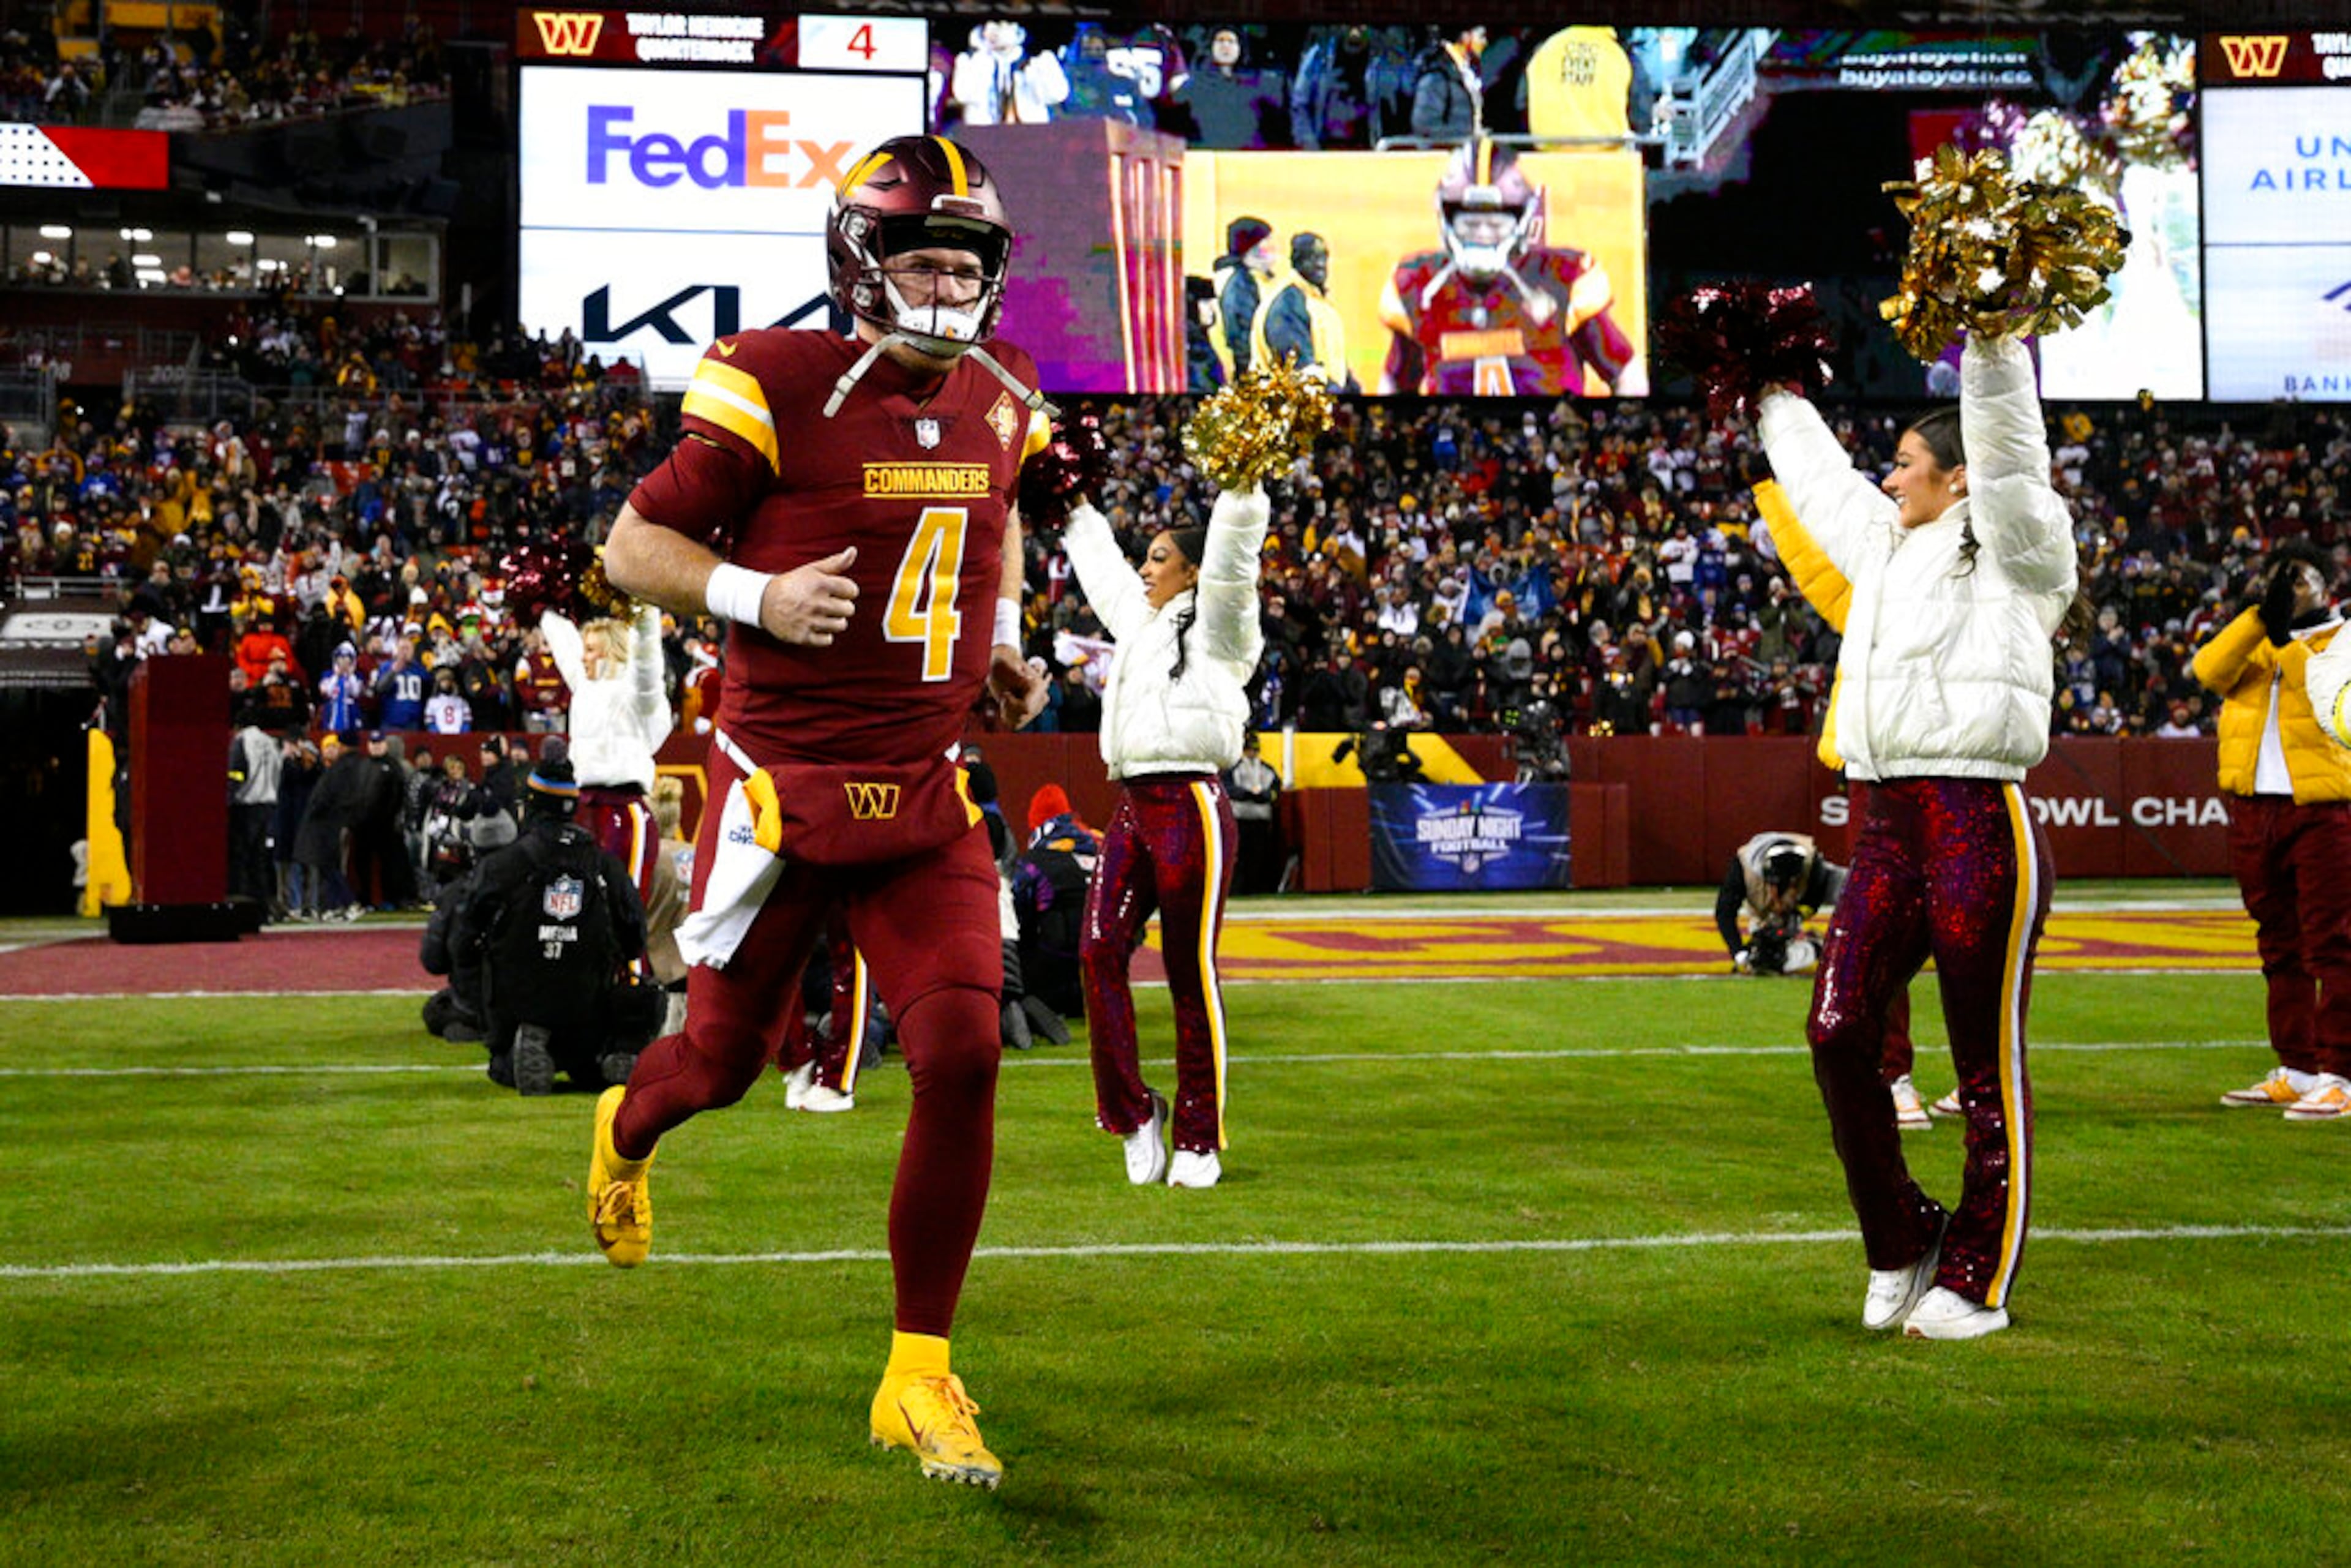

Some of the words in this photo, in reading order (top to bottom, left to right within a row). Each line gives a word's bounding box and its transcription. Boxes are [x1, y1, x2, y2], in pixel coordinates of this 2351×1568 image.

[847, 24, 877, 60] 4
[586, 105, 855, 190] FedEx
[583, 283, 854, 344] KIA
[864, 468, 989, 493] COMMANDERS
[882, 507, 968, 682] 4
[395, 674, 422, 700] 10
[444, 706, 455, 724] 8
[1416, 816, 1476, 842] SUNDAY
[1477, 814, 1524, 839] NIGHT
[1430, 838, 1510, 854] FOOTBALL
[550, 893, 576, 913] NFL
[538, 925, 578, 942] MEDIA
[543, 942, 563, 959] 37
